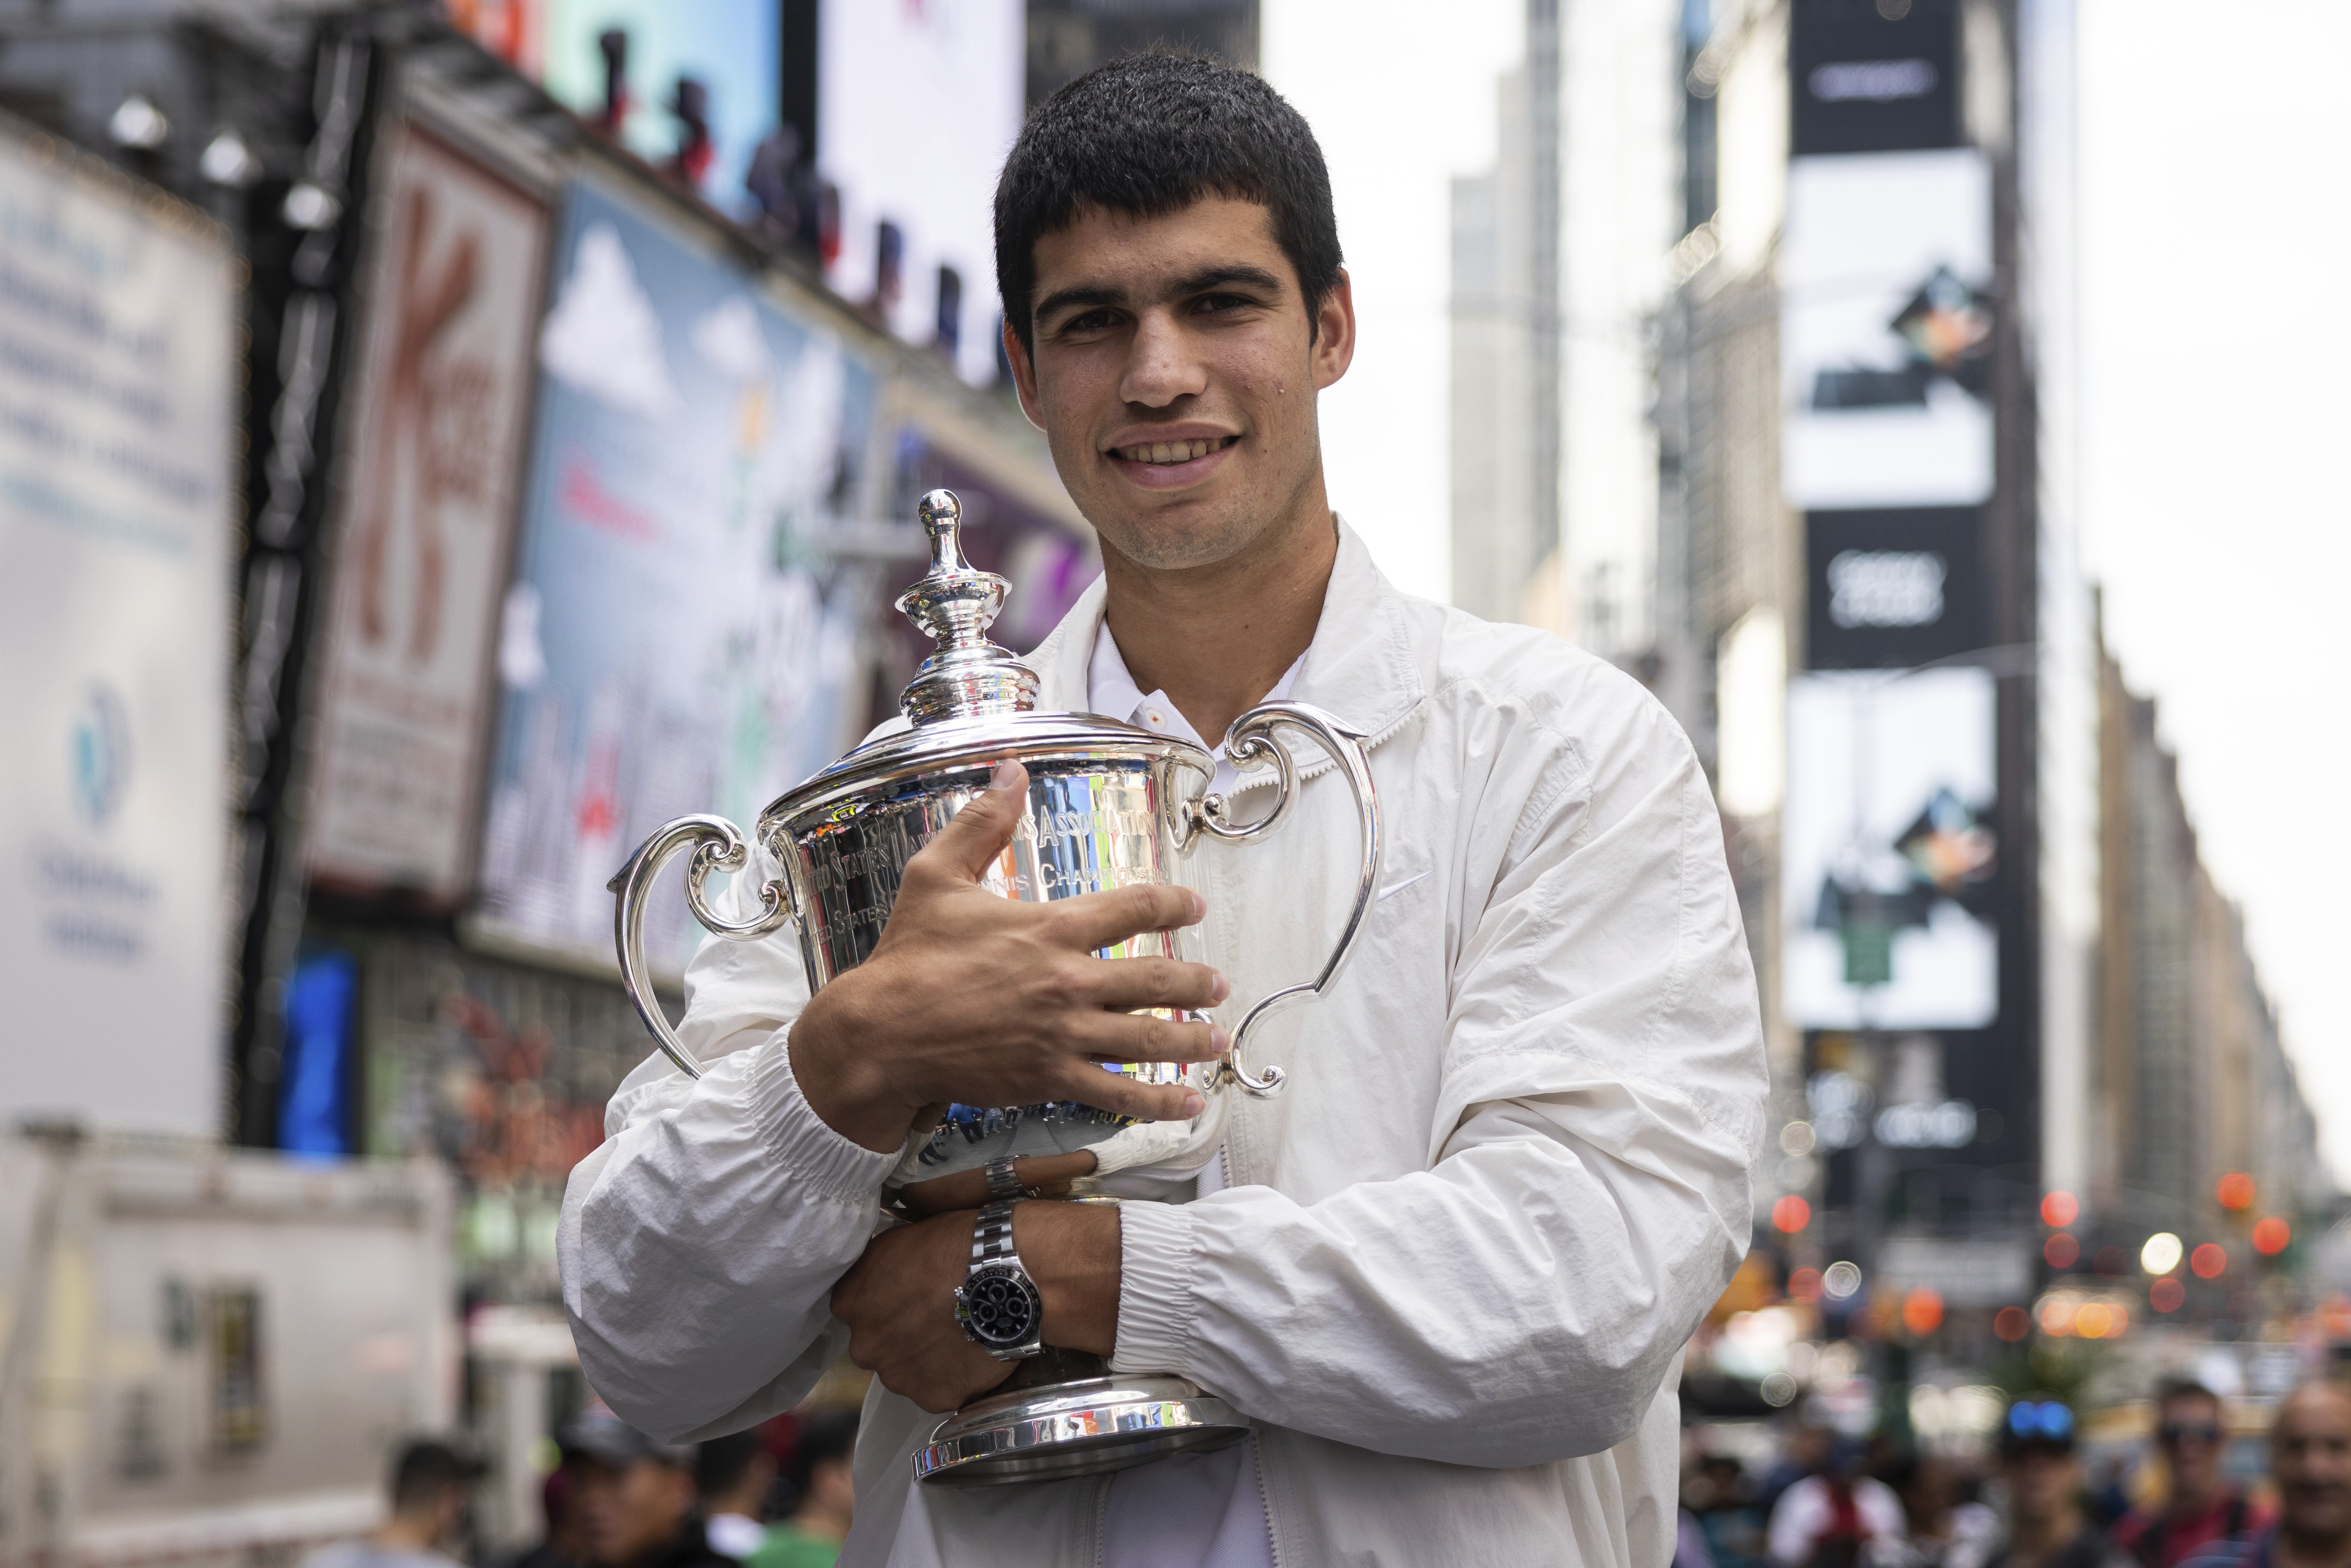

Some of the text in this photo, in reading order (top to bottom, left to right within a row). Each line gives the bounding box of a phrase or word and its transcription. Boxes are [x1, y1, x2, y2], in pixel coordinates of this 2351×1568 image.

[830, 843, 891, 892] STATES
[889, 830, 939, 874] LAW
[1038, 804, 1157, 849] ASSOCIATION
[834, 903, 889, 935] STATES
